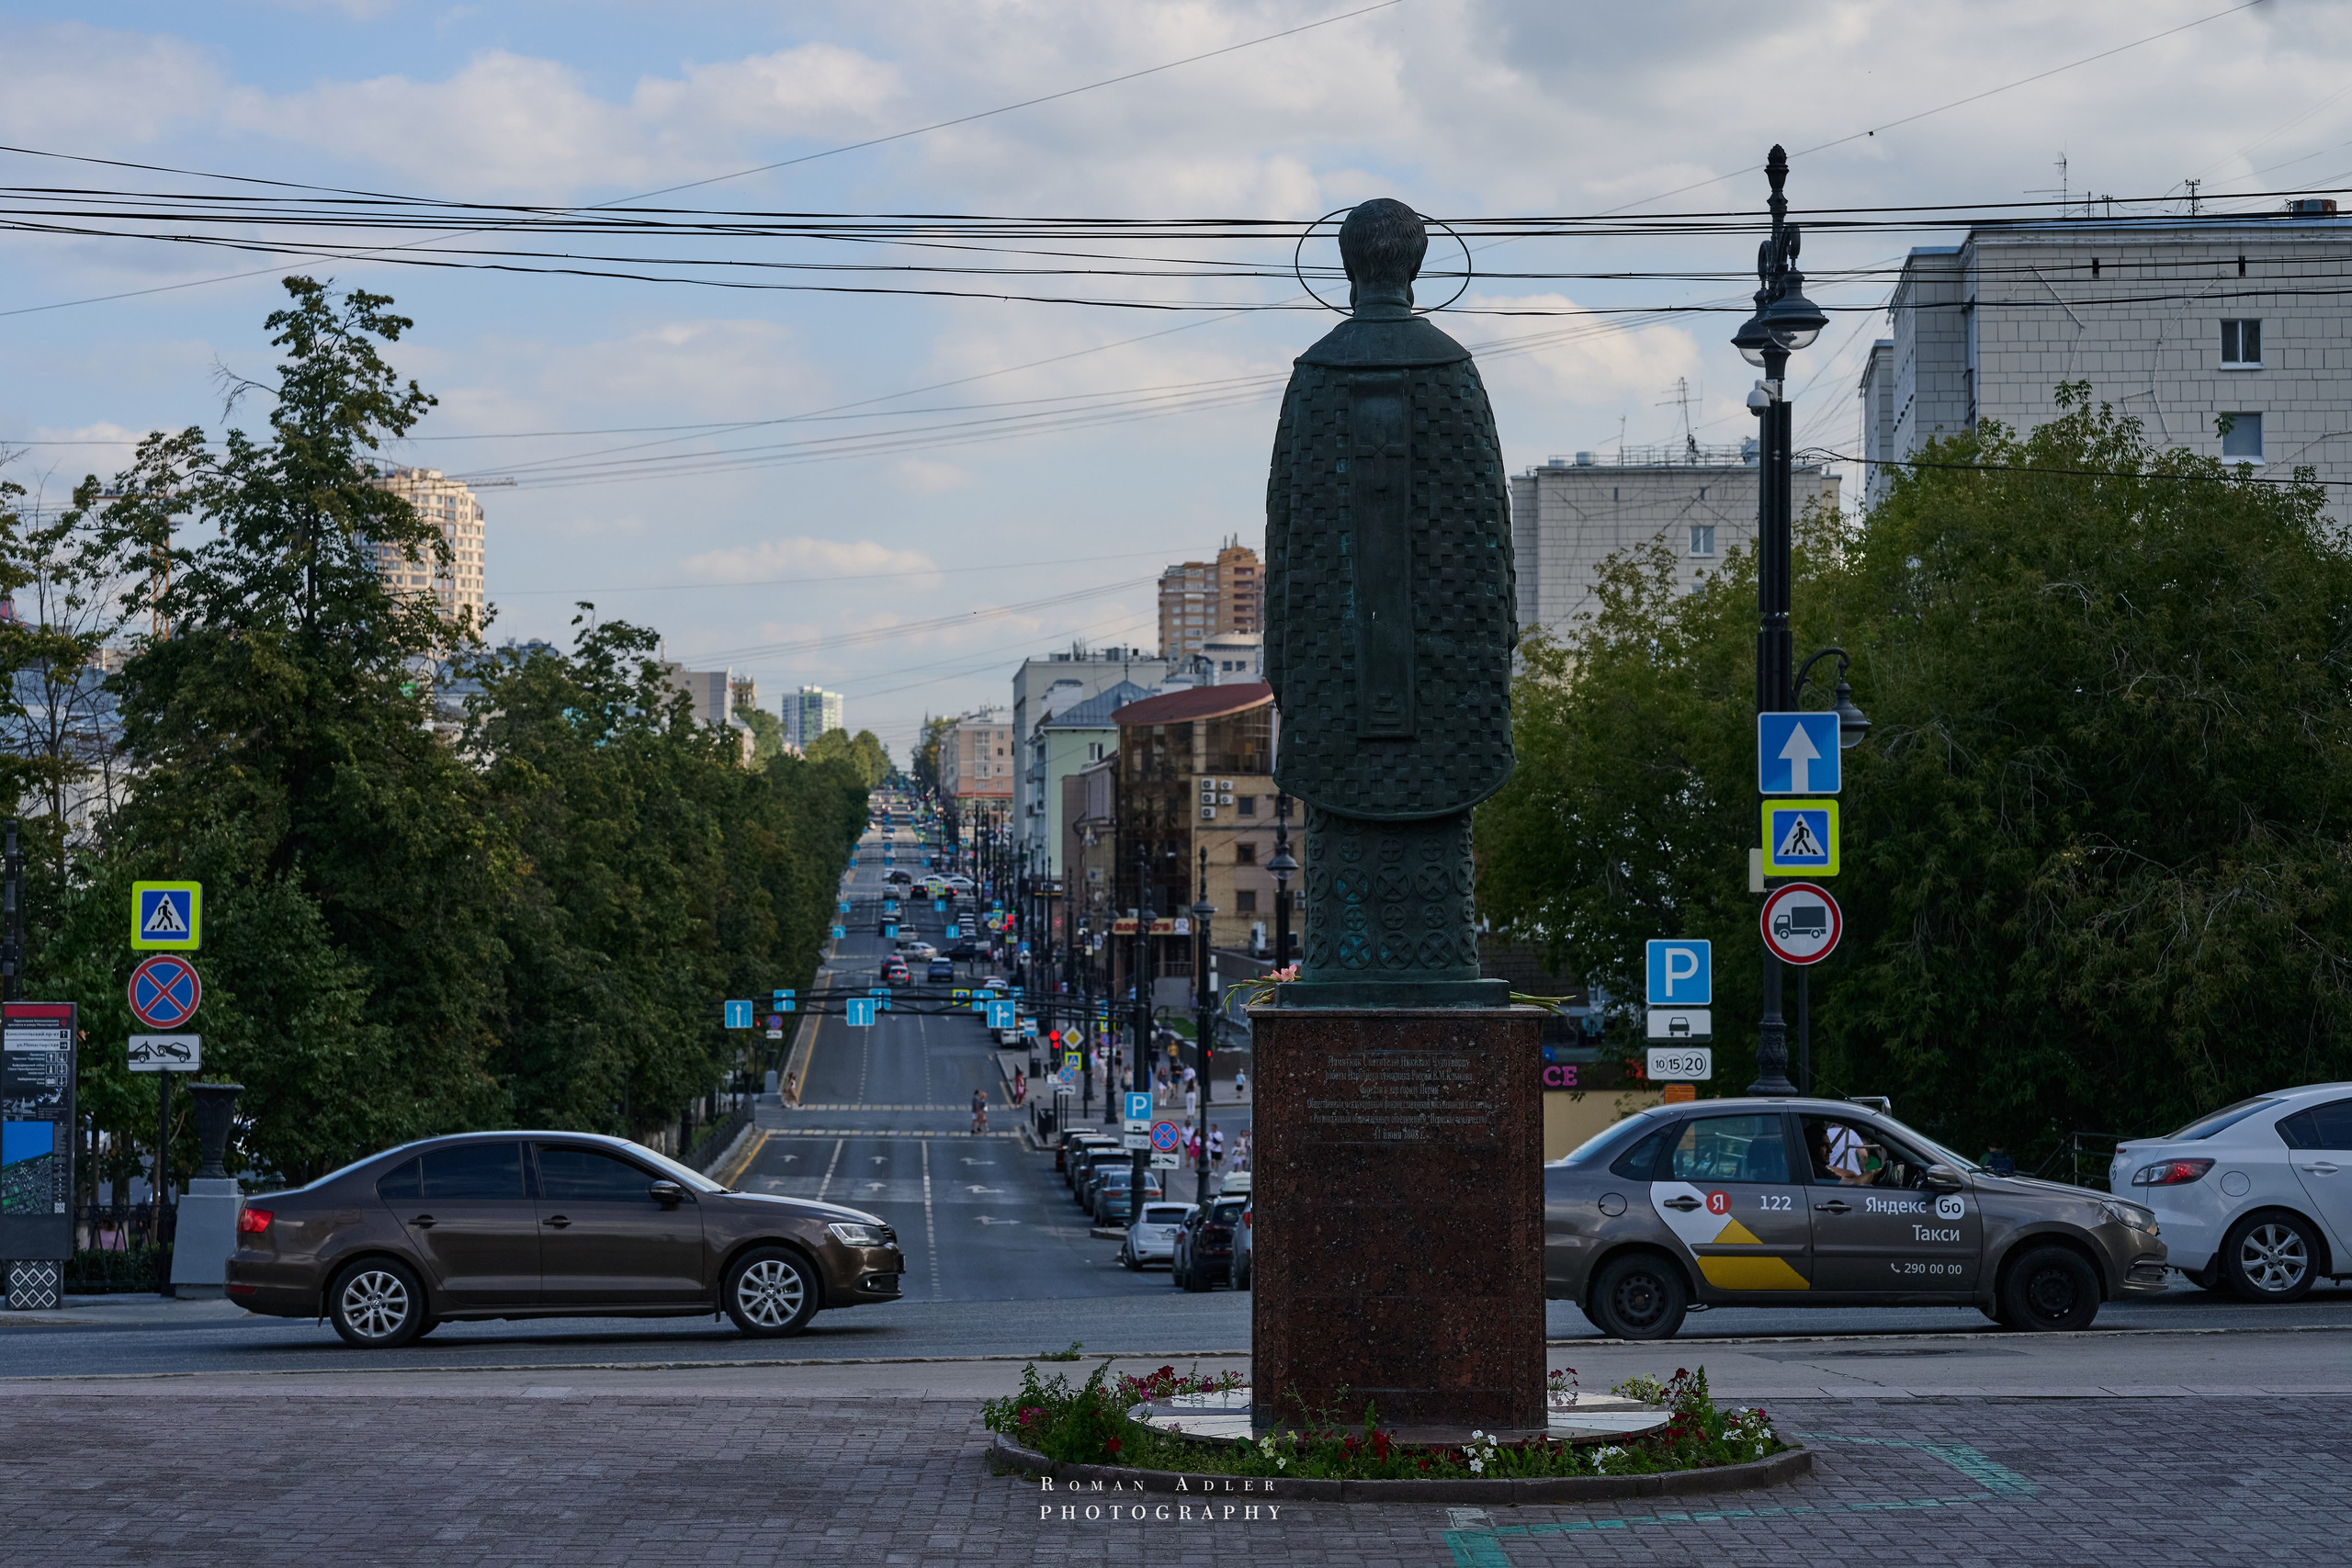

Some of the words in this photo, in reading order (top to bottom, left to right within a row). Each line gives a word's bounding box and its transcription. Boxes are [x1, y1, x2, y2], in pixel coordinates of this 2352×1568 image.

[1665, 948, 1699, 997] P
[1655, 1060, 1665, 1069] 10
[1668, 1059, 1680, 1070] 15
[1685, 1058, 1703, 1071] 20
[1132, 1095, 1147, 1117] P
[1383, 1131, 1402, 1139] июня
[1712, 1194, 1724, 1210] Я
[1760, 1196, 1792, 1211] 122
[1865, 1197, 1927, 1215] Яндекс
[1939, 1198, 1961, 1214] Go
[1912, 1225, 1960, 1241] Такси
[1904, 1263, 1925, 1275] 290
[1929, 1263, 1944, 1275] 00
[1947, 1263, 1962, 1275] 00
